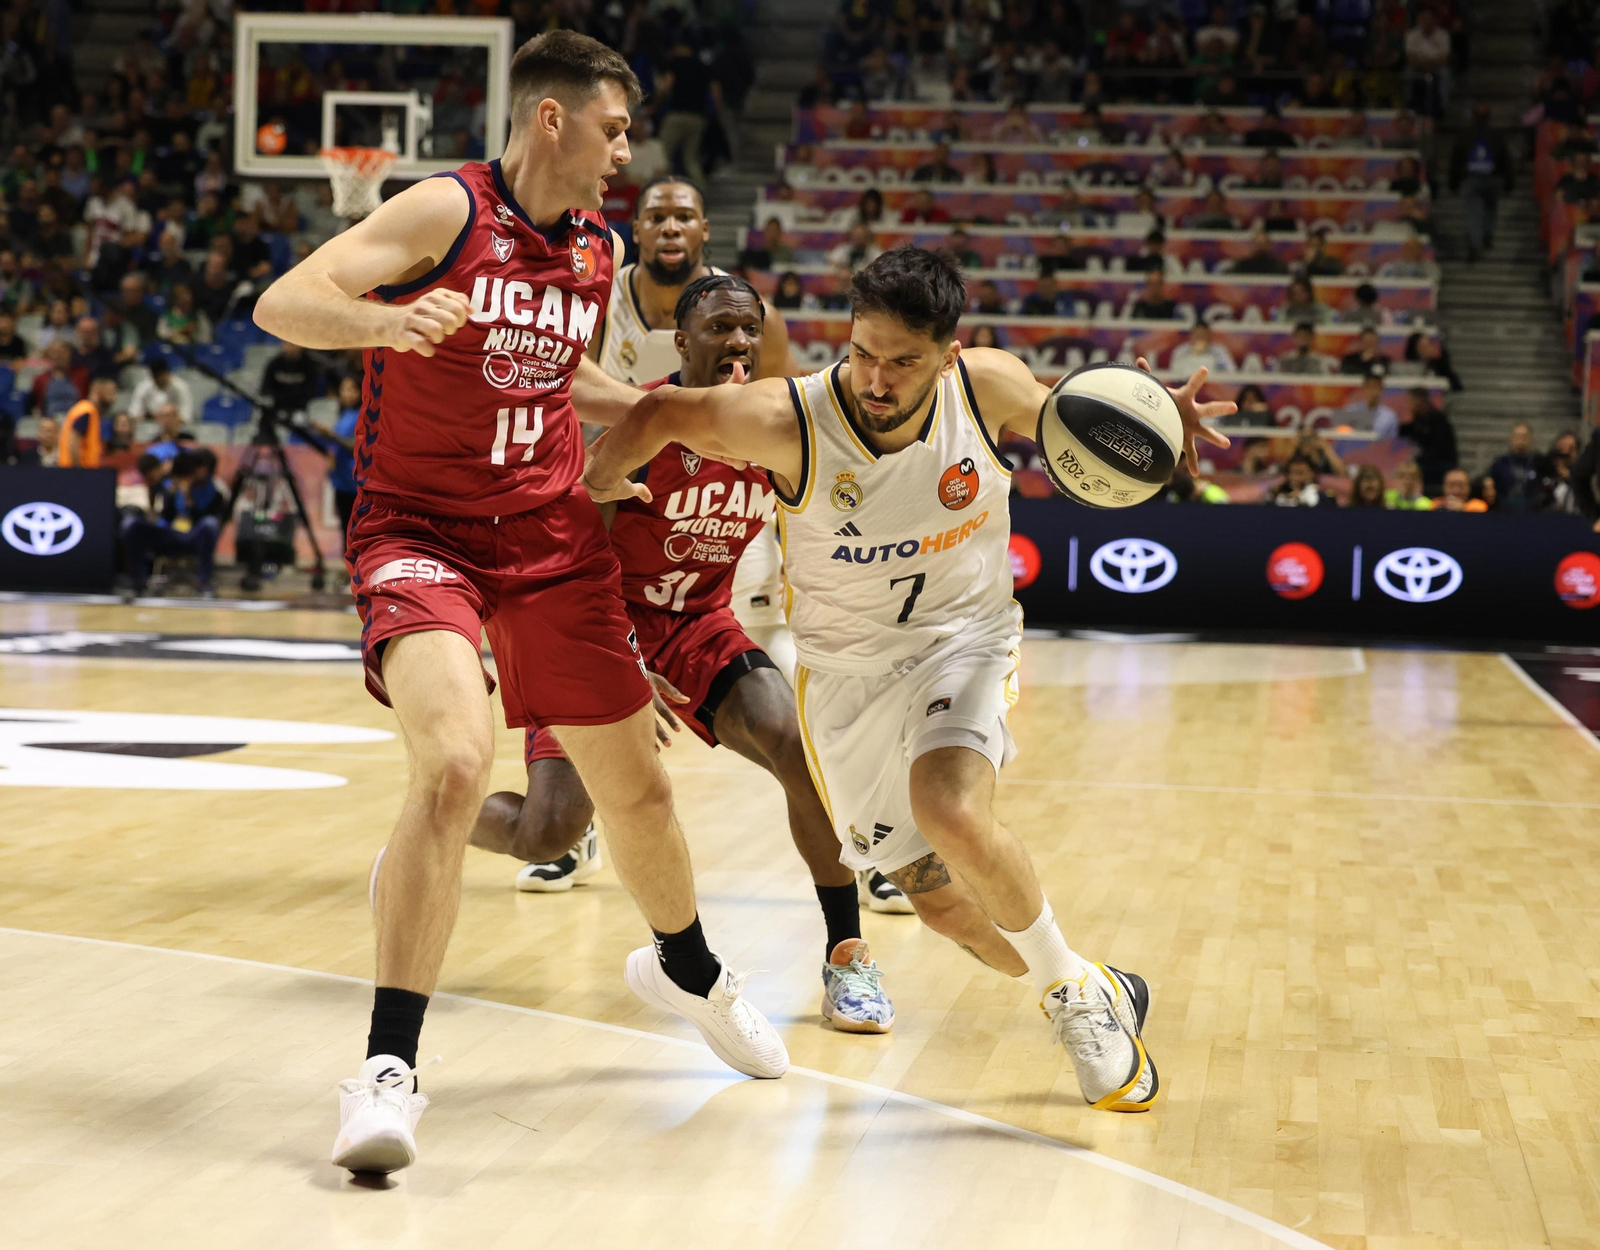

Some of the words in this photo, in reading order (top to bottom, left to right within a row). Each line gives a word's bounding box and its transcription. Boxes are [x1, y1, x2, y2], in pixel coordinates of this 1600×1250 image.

[467, 277, 599, 349] UCAM
[483, 328, 573, 365] MURCIA
[522, 358, 540, 366] Costa
[518, 377, 532, 389] DE
[534, 377, 566, 389] MURC
[491, 406, 544, 466] 14
[1057, 449, 1084, 478] 2024
[664, 481, 777, 522] UCAM
[945, 481, 967, 493] Copa
[670, 517, 748, 539] MURCIA
[831, 511, 989, 564] AUTOHERO
[692, 551, 707, 561] DE
[643, 570, 701, 612] 31
[890, 573, 926, 623] 7
